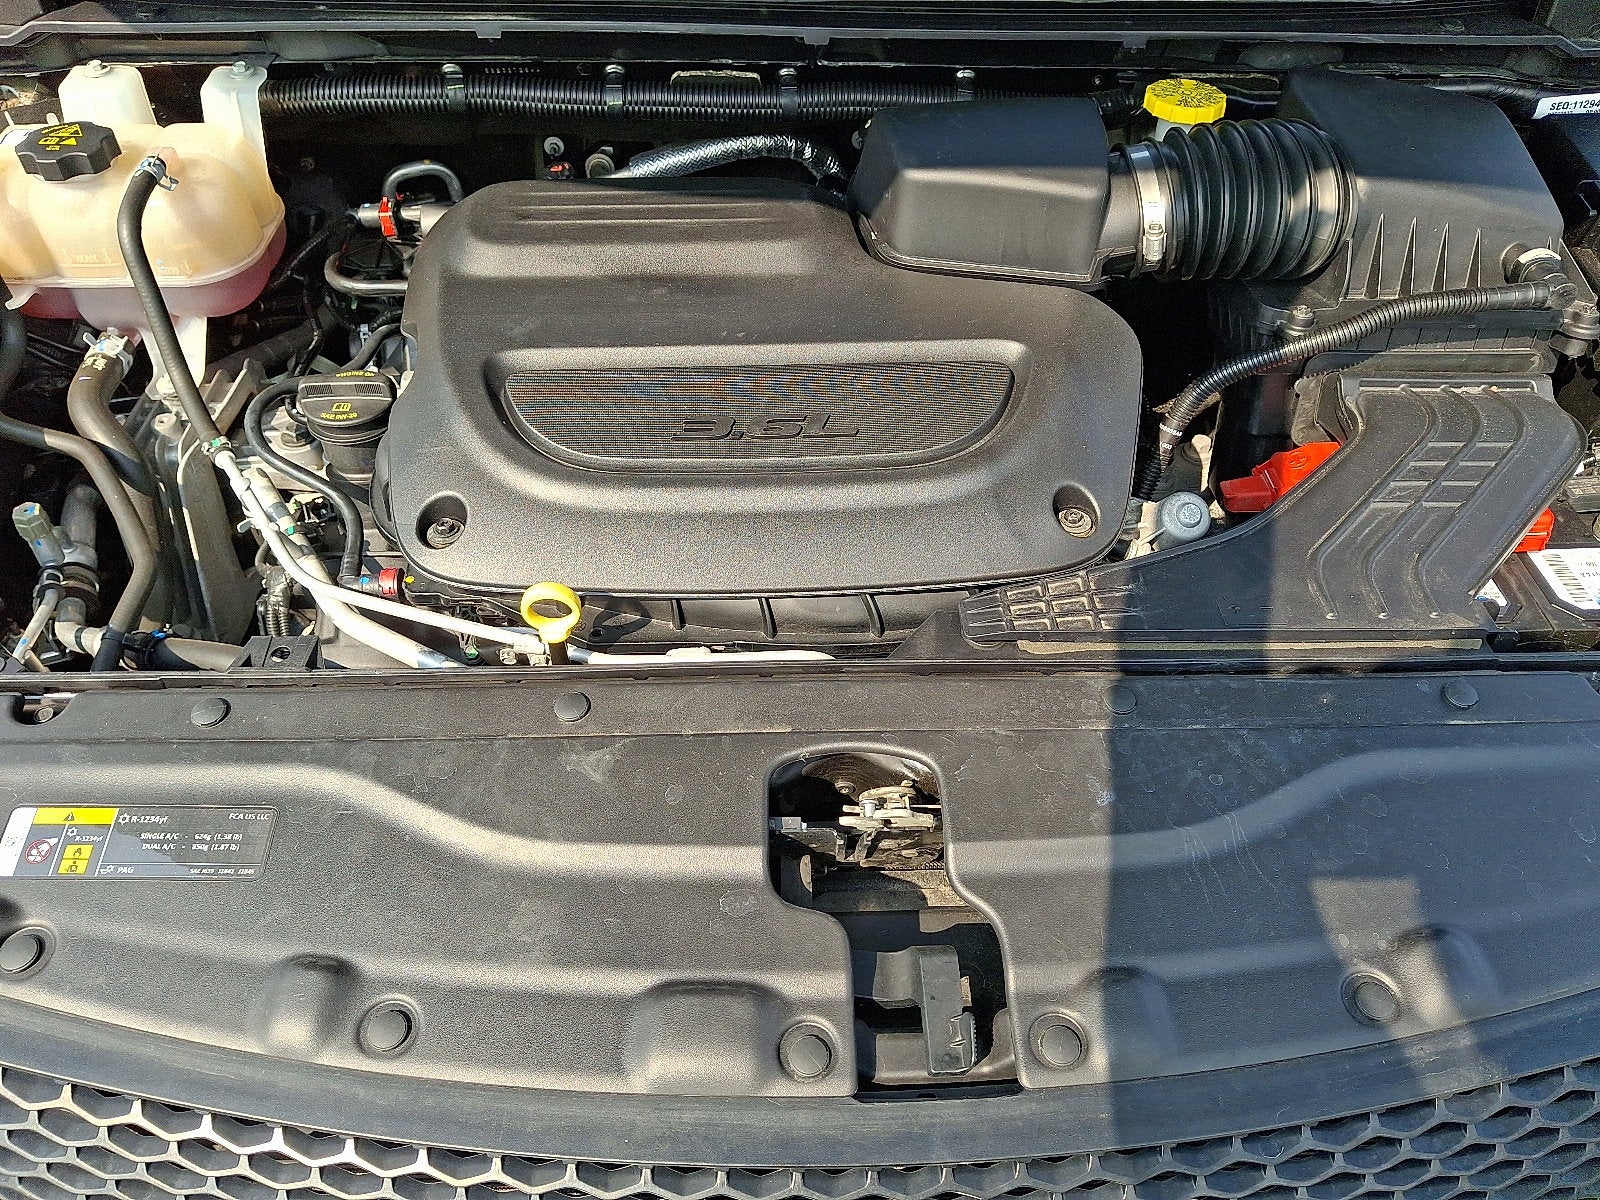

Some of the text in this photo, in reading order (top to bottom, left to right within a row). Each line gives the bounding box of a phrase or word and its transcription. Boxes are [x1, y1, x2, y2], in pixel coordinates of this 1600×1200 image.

[671, 414, 860, 440] 3.6L
[131, 815, 169, 825] R-1234yf
[228, 812, 244, 820] FCA
[140, 832, 165, 840] SINGLE
[164, 832, 180, 841] A/C
[161, 843, 177, 851] A/C
[116, 866, 135, 874] PAG
